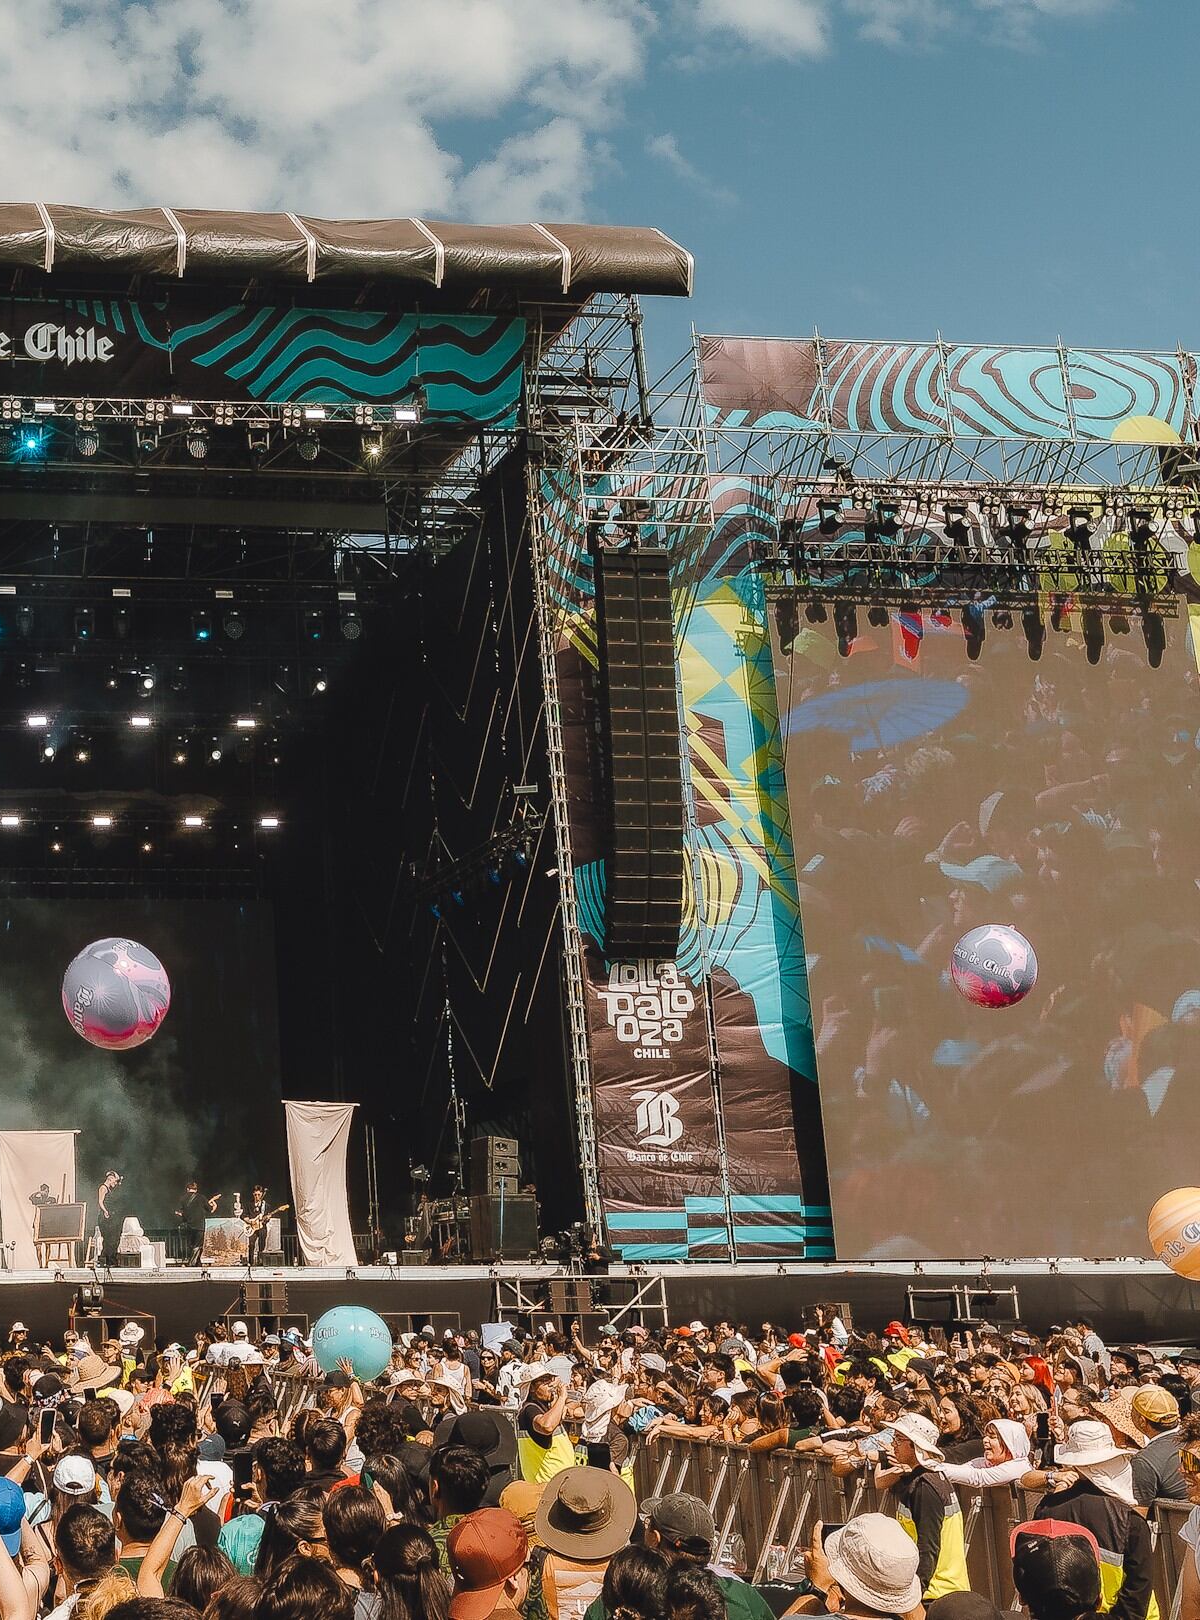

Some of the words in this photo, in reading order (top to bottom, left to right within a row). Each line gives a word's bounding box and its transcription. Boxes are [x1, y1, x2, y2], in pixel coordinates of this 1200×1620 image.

[24, 322, 115, 366] Chile
[982, 959, 1012, 979] Chile
[633, 1048, 671, 1059] CHILE
[626, 1150, 657, 1163] Banco
[658, 1152, 669, 1162] de
[670, 1150, 694, 1164] Chile
[1164, 1240, 1185, 1258] de
[316, 1326, 339, 1342] Chile
